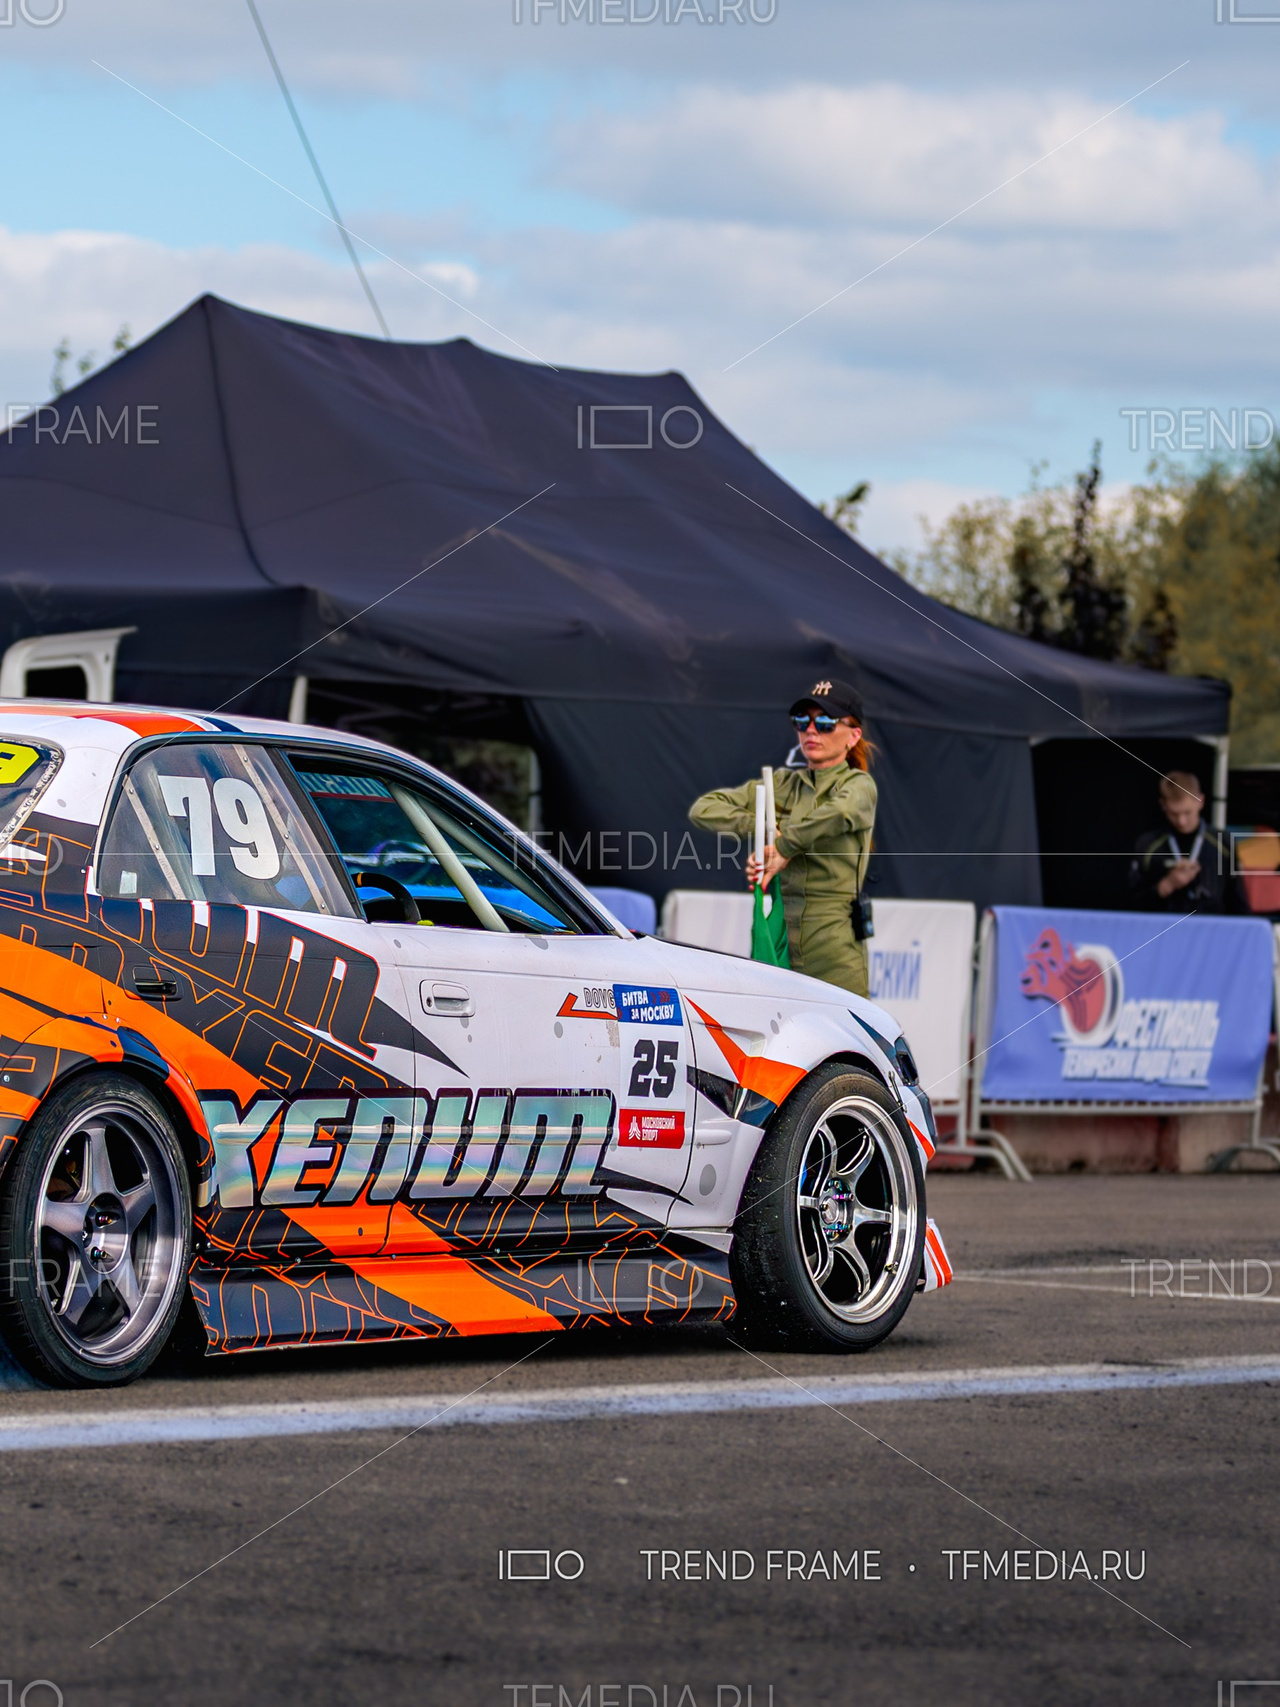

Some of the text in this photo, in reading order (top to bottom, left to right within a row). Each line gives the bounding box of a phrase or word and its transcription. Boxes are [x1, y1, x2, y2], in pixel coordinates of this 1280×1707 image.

[158, 775, 280, 880] 79
[622, 990, 649, 1007] БИТВА
[631, 1004, 675, 1023] ЗА МОСКВУ
[628, 1039, 679, 1099] 25
[199, 1090, 616, 1208] XENUM
